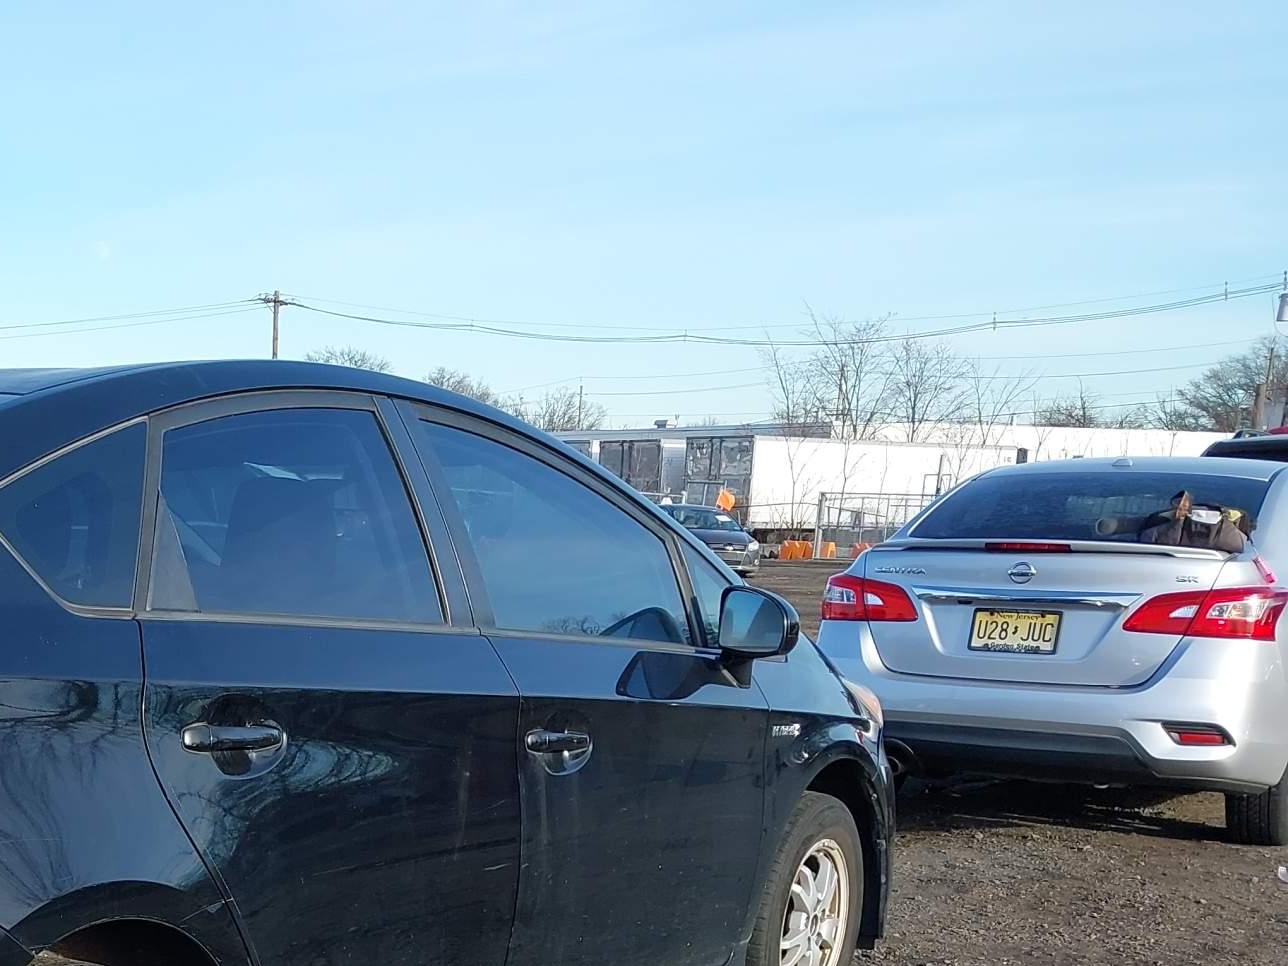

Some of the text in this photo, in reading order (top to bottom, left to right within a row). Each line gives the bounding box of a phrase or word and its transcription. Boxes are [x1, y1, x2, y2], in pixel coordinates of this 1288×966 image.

[1016, 613, 1041, 621] Jersey
[977, 619, 1054, 643] U28 JUC
